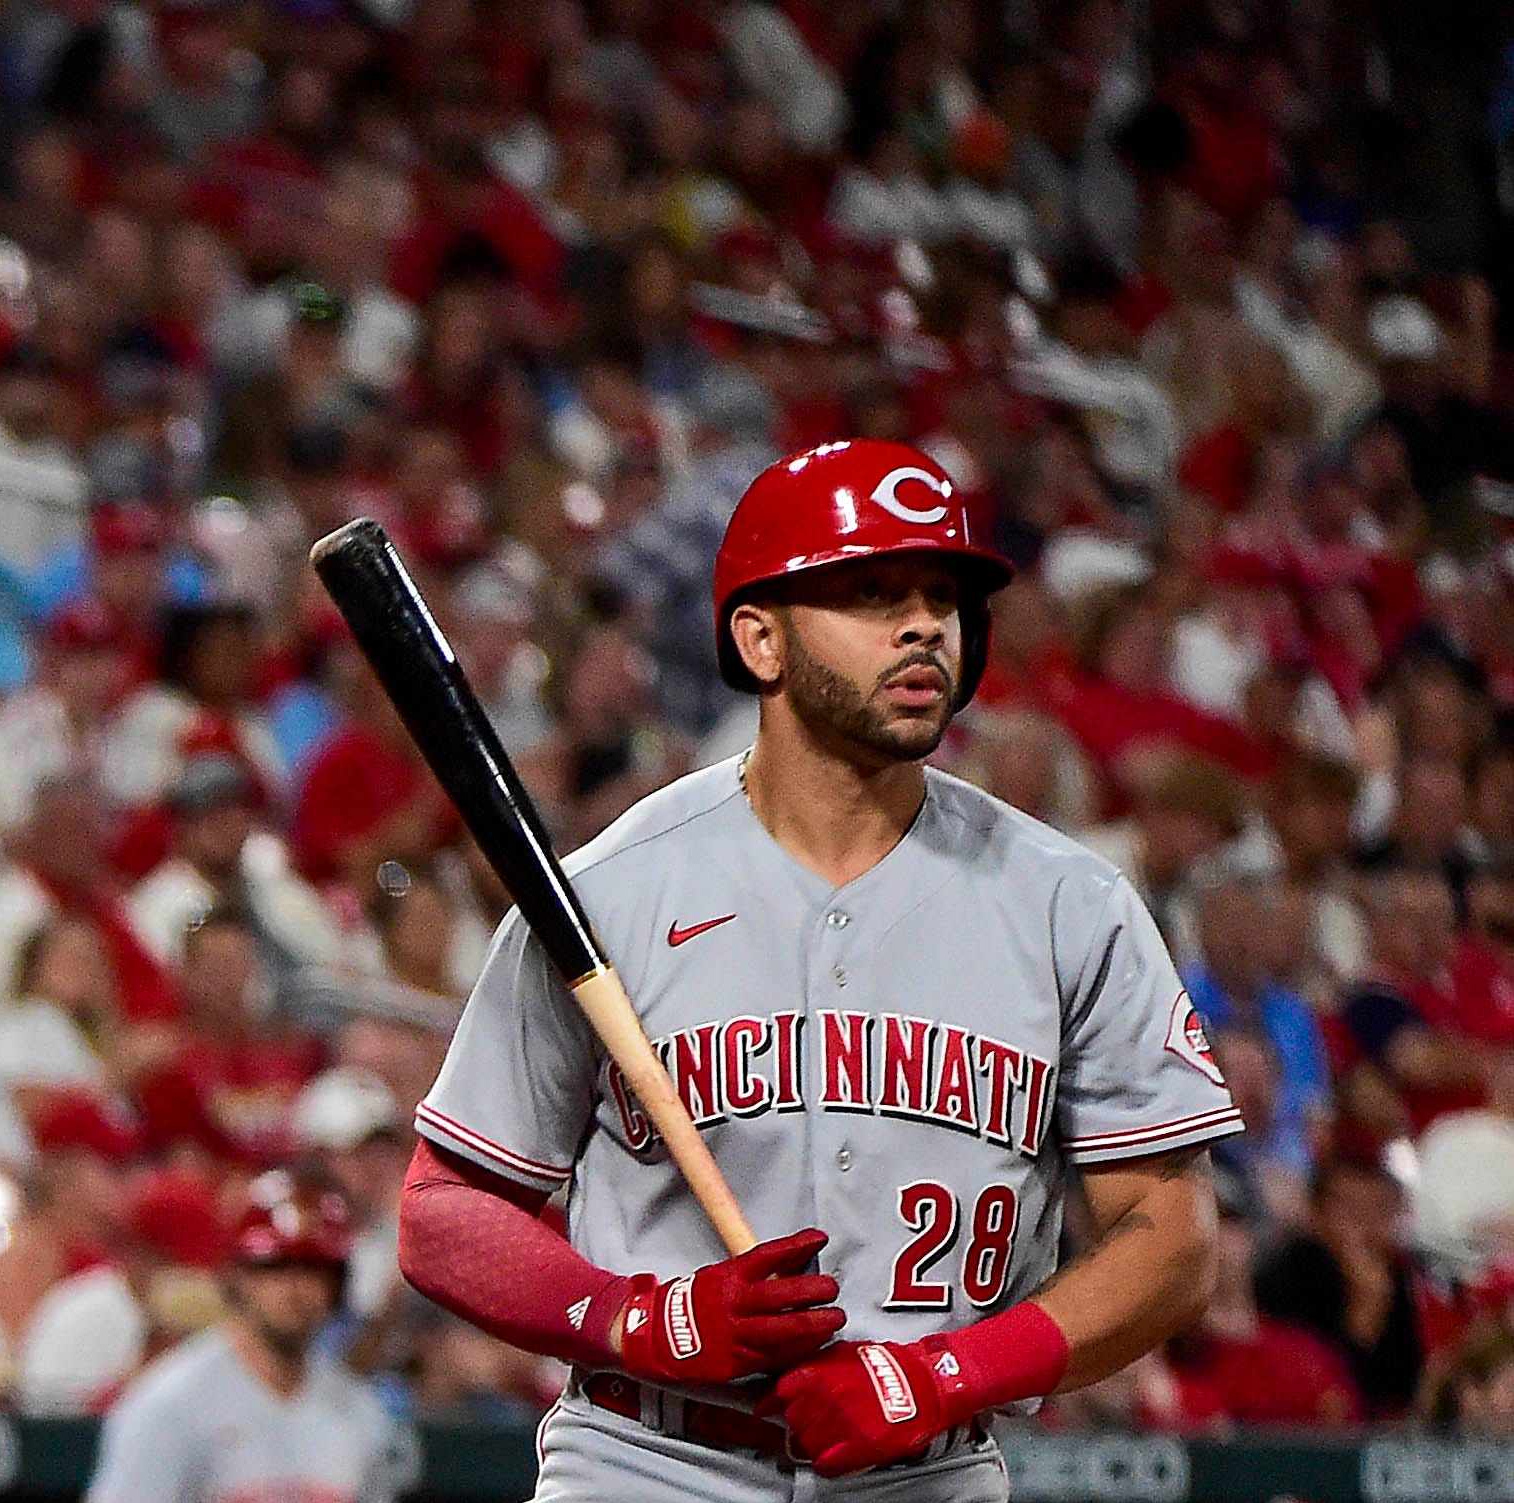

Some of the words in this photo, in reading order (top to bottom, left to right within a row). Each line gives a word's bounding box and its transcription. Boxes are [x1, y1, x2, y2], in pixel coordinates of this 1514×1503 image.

[870, 466, 952, 524] C
[607, 1008, 1053, 1158] CNCINNATI
[882, 1178, 1020, 1312] 28
